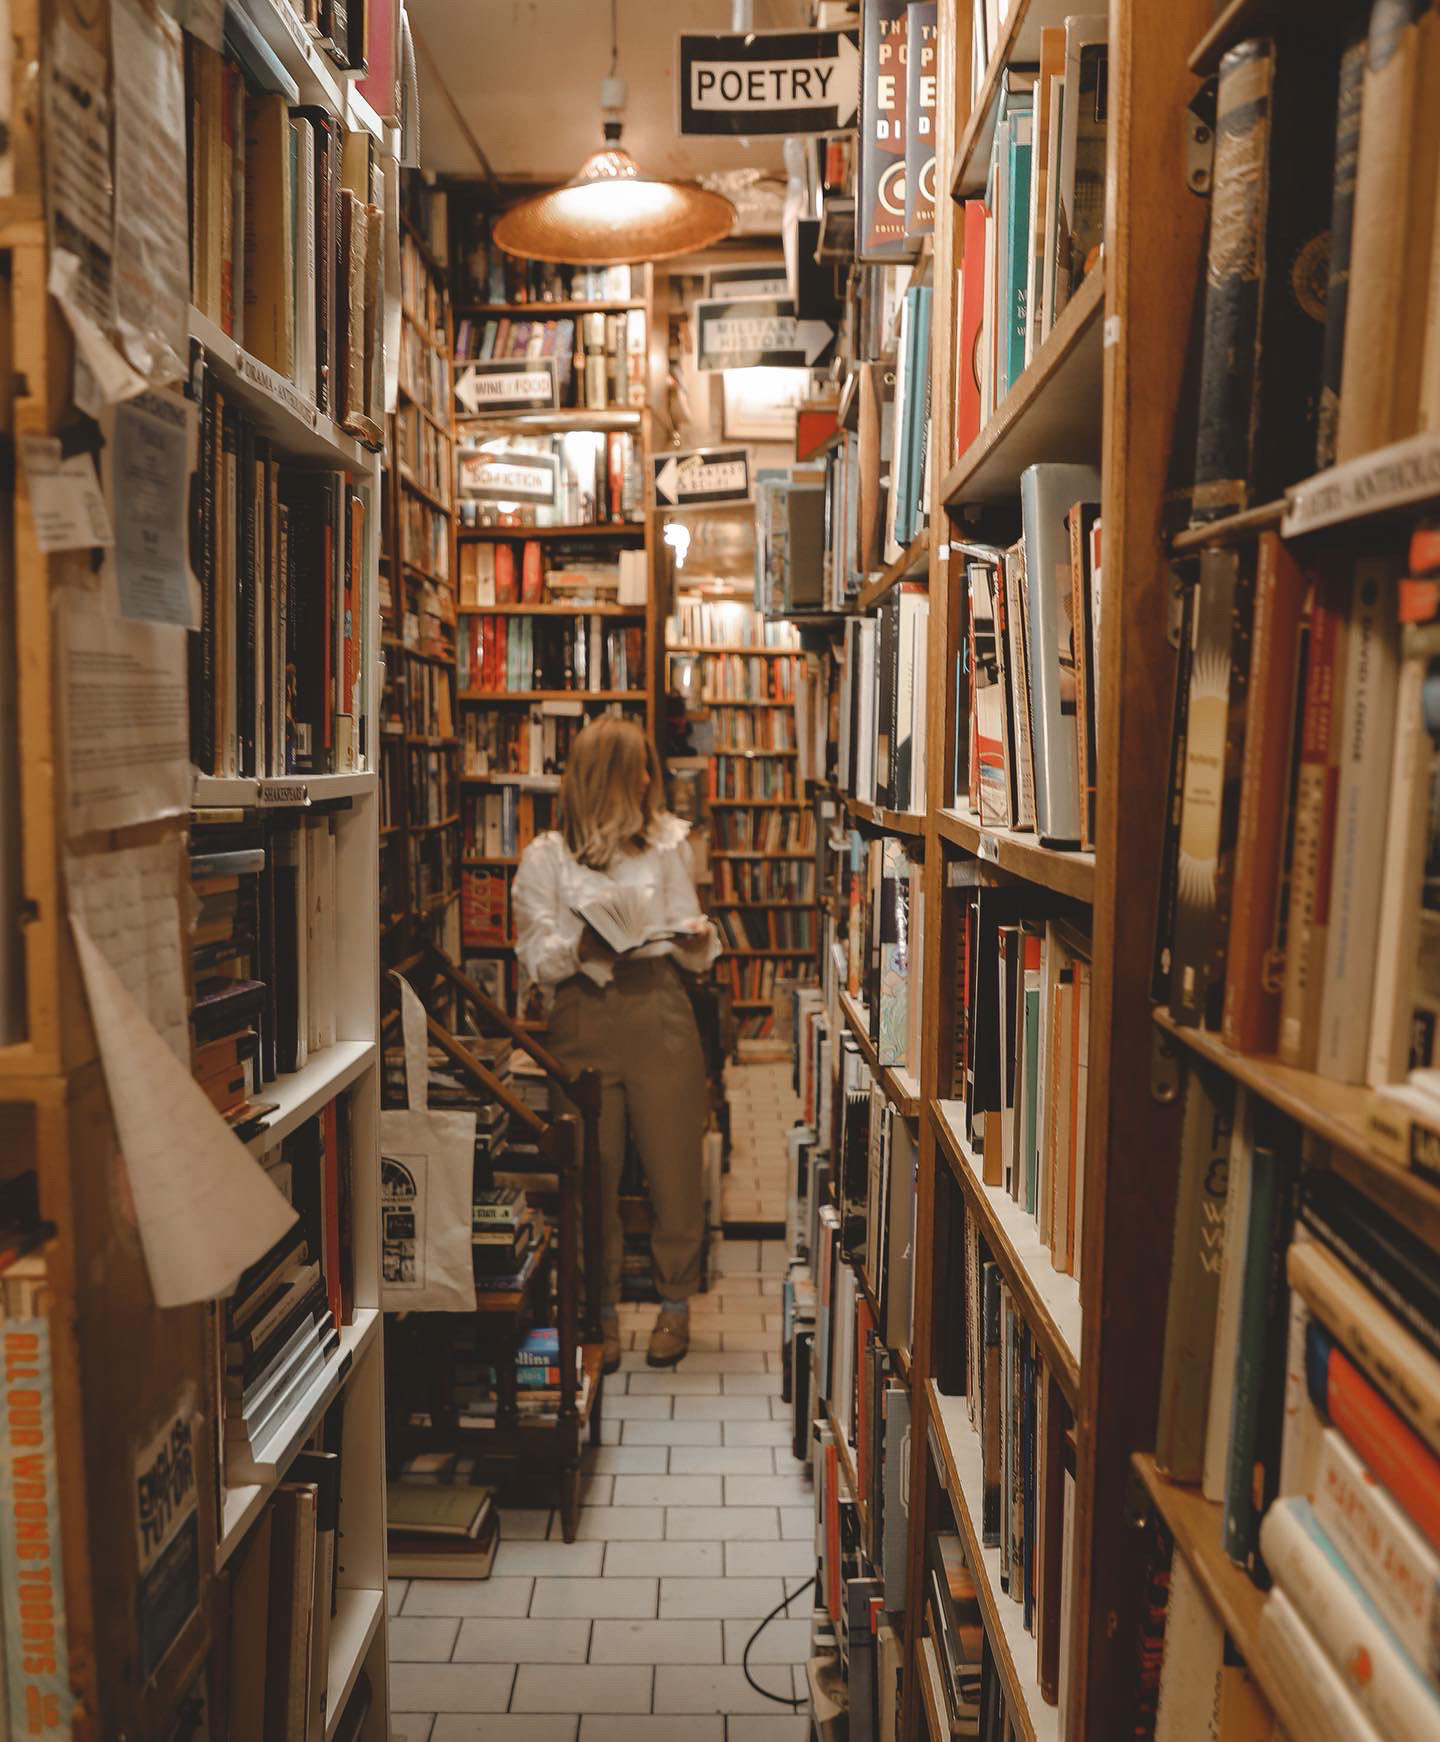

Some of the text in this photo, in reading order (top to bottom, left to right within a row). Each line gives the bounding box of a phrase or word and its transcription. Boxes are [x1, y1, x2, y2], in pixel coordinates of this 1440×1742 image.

[697, 65, 834, 102] POETRY
[717, 318, 799, 335] MILITARY
[721, 334, 798, 350] HISTORY
[474, 380, 504, 396] WINE
[4, 1333, 40, 1384] ALL
[8, 1390, 44, 1446] OUR
[12, 1453, 50, 1560] WRONG
[17, 1567, 57, 1675] TODAYS
